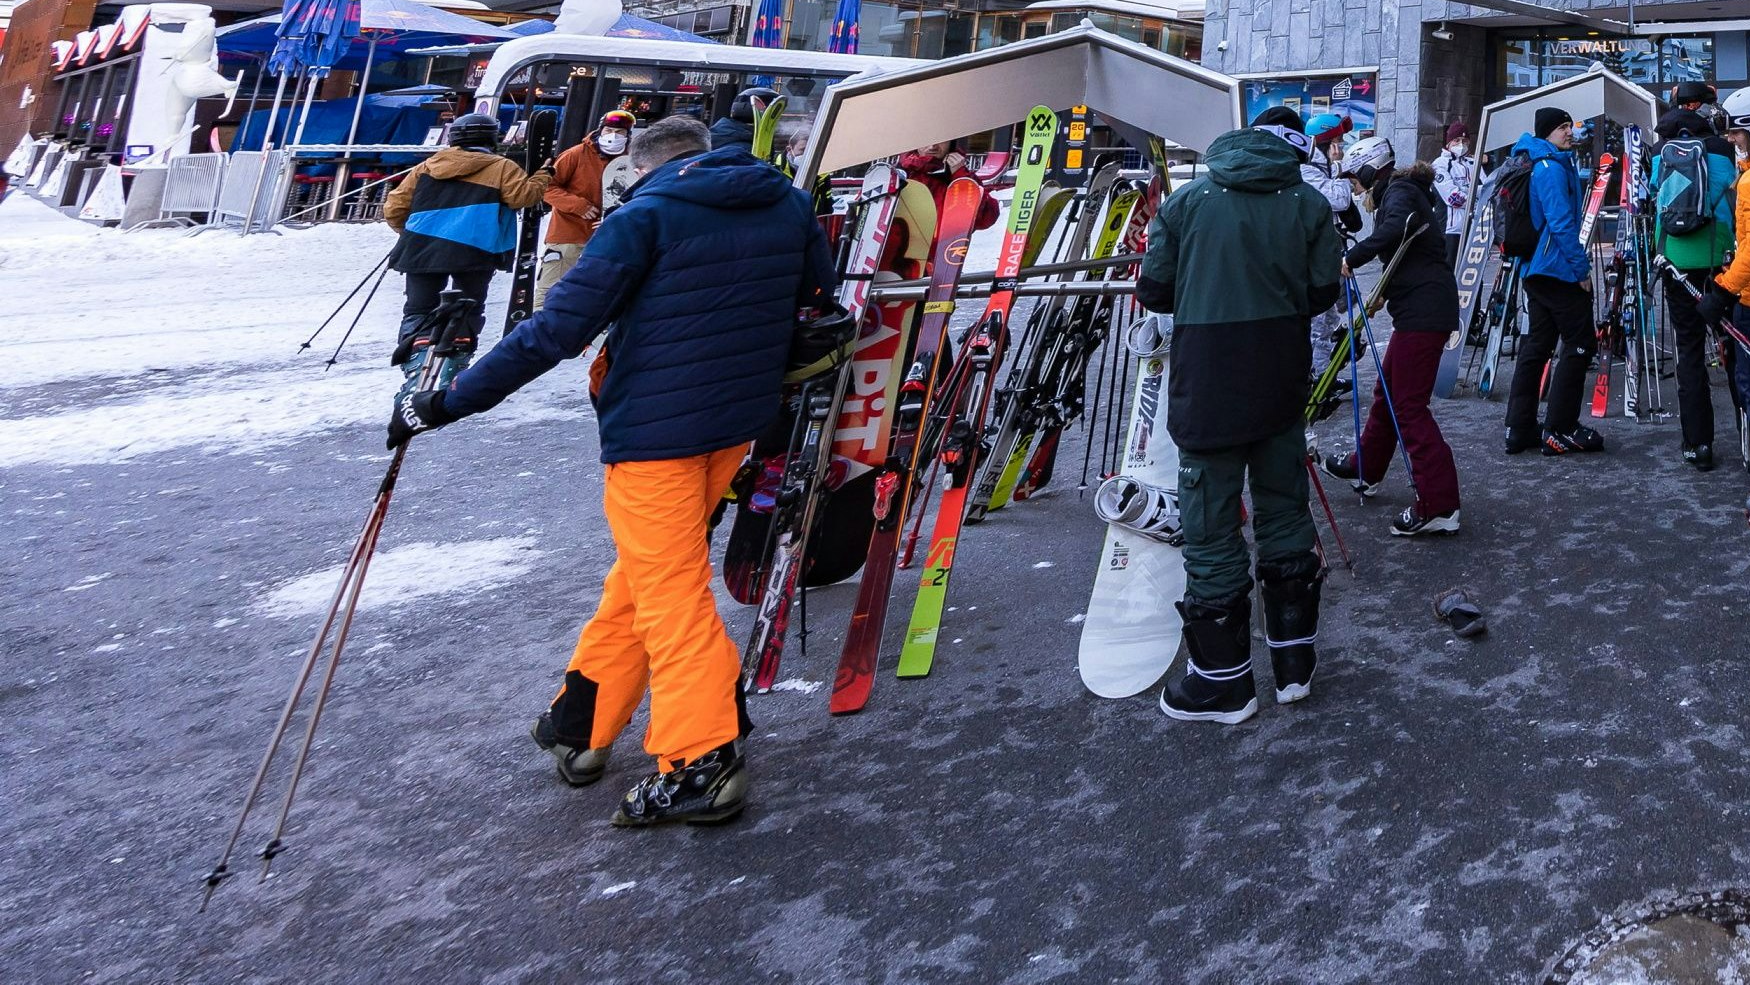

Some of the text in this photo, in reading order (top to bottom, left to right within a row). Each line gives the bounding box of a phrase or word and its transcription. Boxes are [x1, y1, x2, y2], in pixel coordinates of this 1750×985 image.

[1550, 40, 1652, 55] VERWALTUNG
[1072, 123, 1084, 131] 2G
[1631, 130, 1642, 210] ATOMIC
[1458, 206, 1494, 309] ARBOR
[401, 393, 428, 431] OAKLEY
[1138, 374, 1162, 438] RIDE
